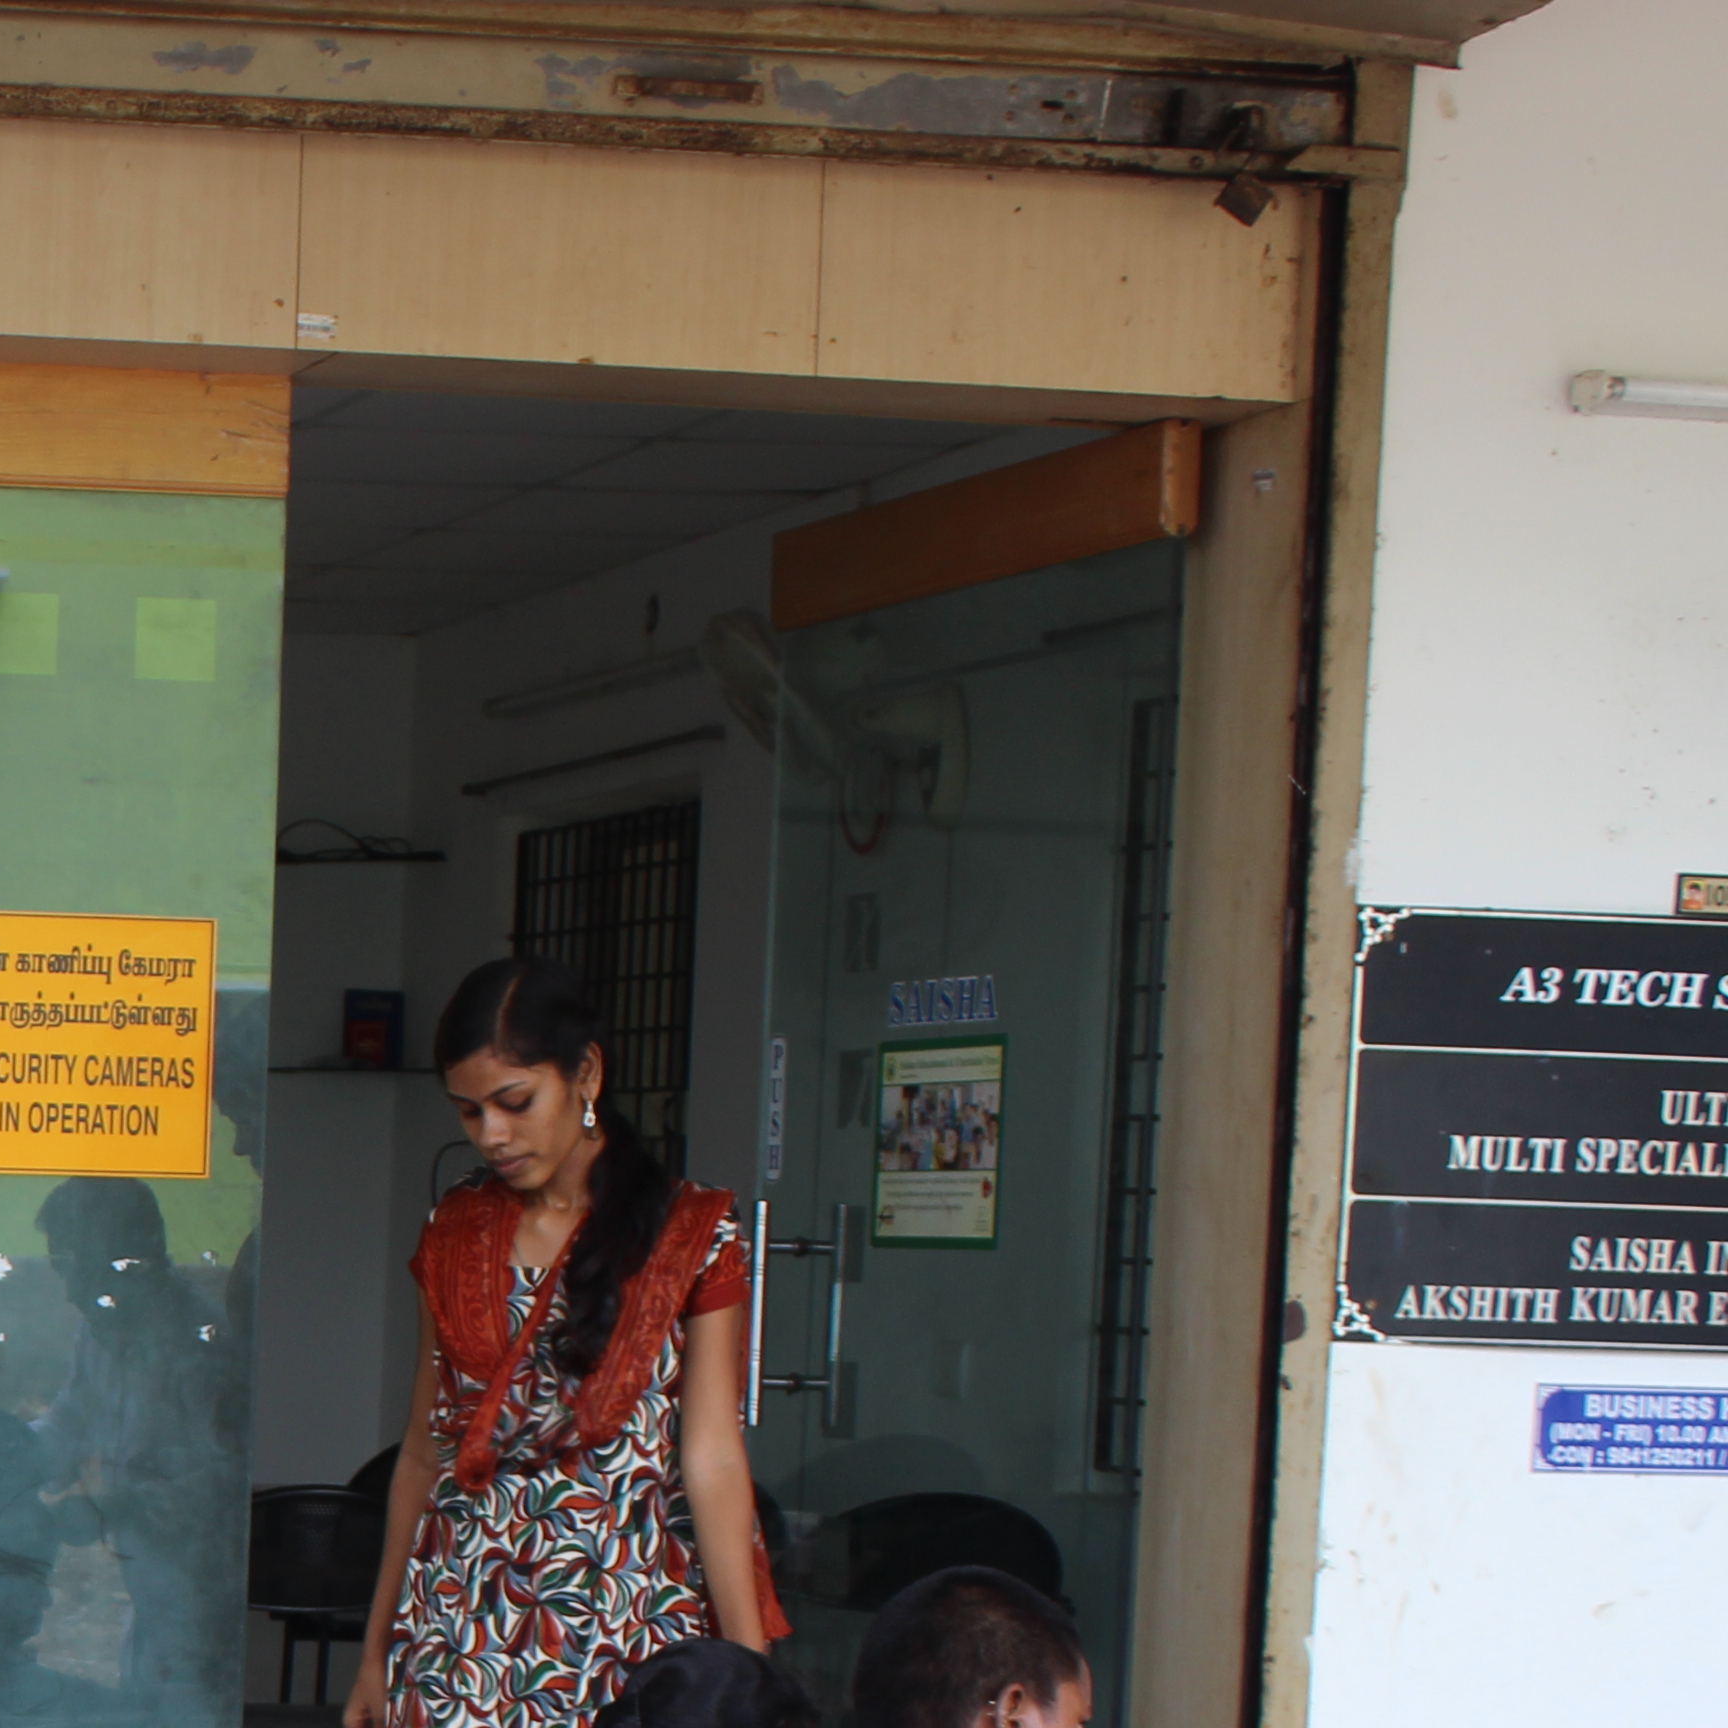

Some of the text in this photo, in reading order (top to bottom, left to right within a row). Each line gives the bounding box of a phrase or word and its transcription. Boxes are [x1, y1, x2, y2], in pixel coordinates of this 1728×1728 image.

[118, 949, 197, 985] கேமரா
[887, 974, 998, 1028] SAISHA
[1499, 966, 1563, 1003] A3
[1572, 967, 1710, 1009] TECH
[83, 1055, 196, 1089] CAMERAS
[27, 1101, 160, 1136] OPERATION
[1660, 1090, 1728, 1127] ULT
[1446, 1134, 1728, 1178] MULTI SPECIAL
[1569, 1236, 1697, 1275] SAISHA
[1393, 1285, 1562, 1324] AKSHITH
[1568, 1287, 1699, 1325] KUMAR
[1584, 1393, 1716, 1421] BUSINESS
